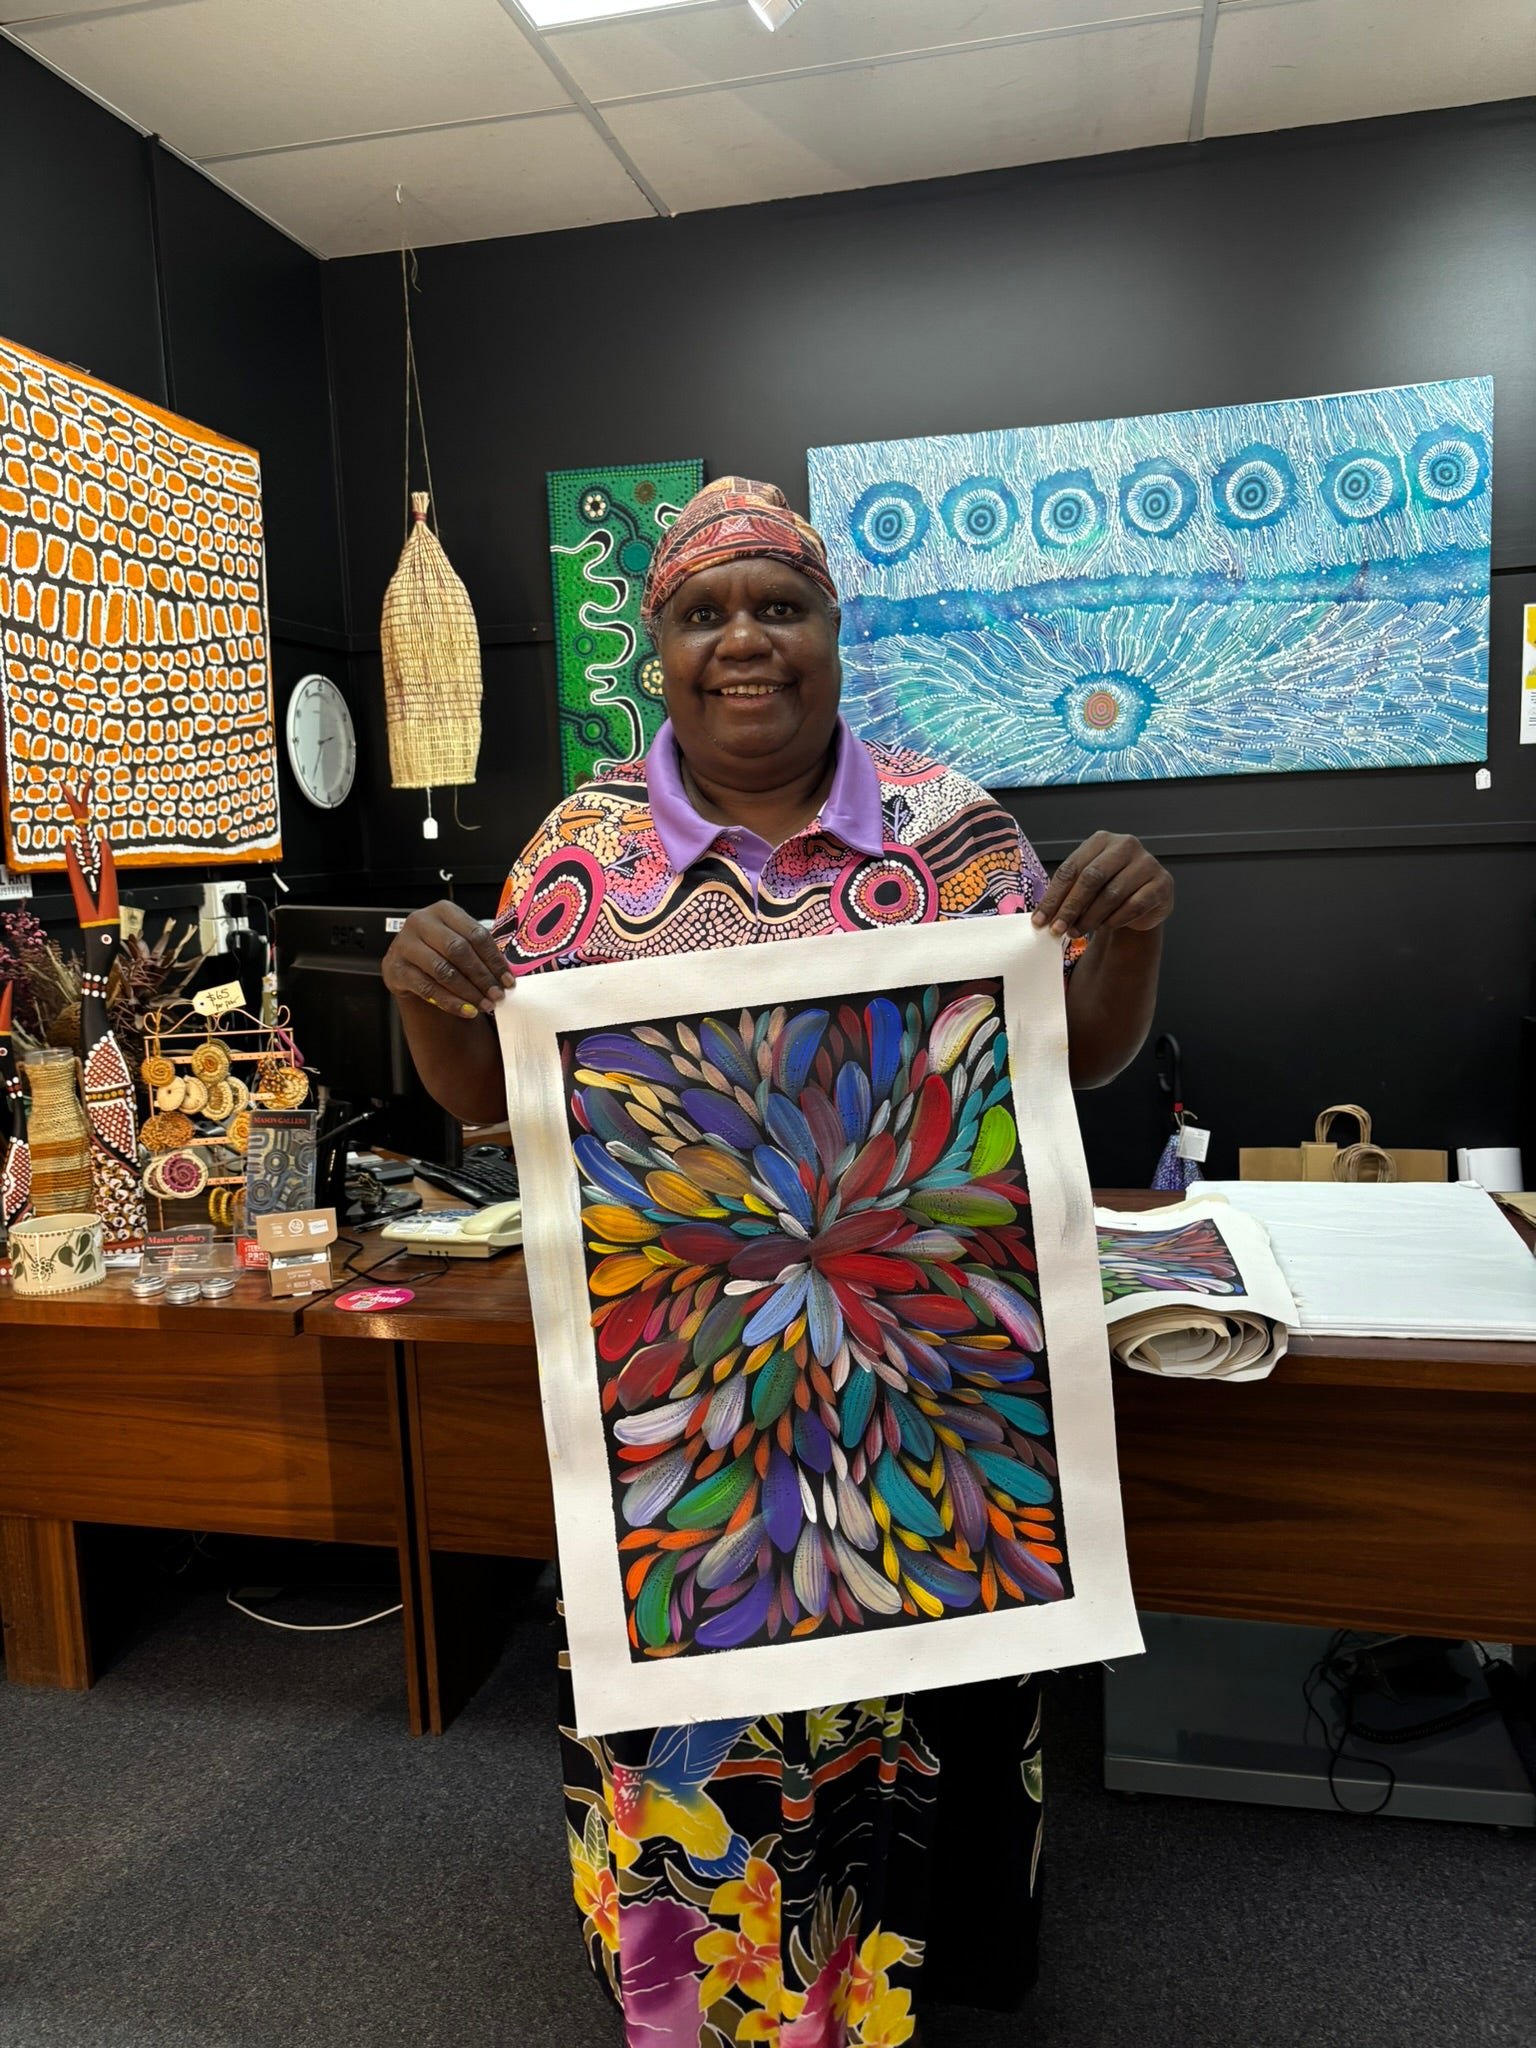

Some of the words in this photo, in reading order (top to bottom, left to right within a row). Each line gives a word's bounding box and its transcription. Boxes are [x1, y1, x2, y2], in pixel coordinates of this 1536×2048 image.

[0, 886, 30, 896] USTRALIA
[206, 988, 230, 1006] $65
[147, 1236, 174, 1245] Mason
[176, 1234, 206, 1244] Gallery
